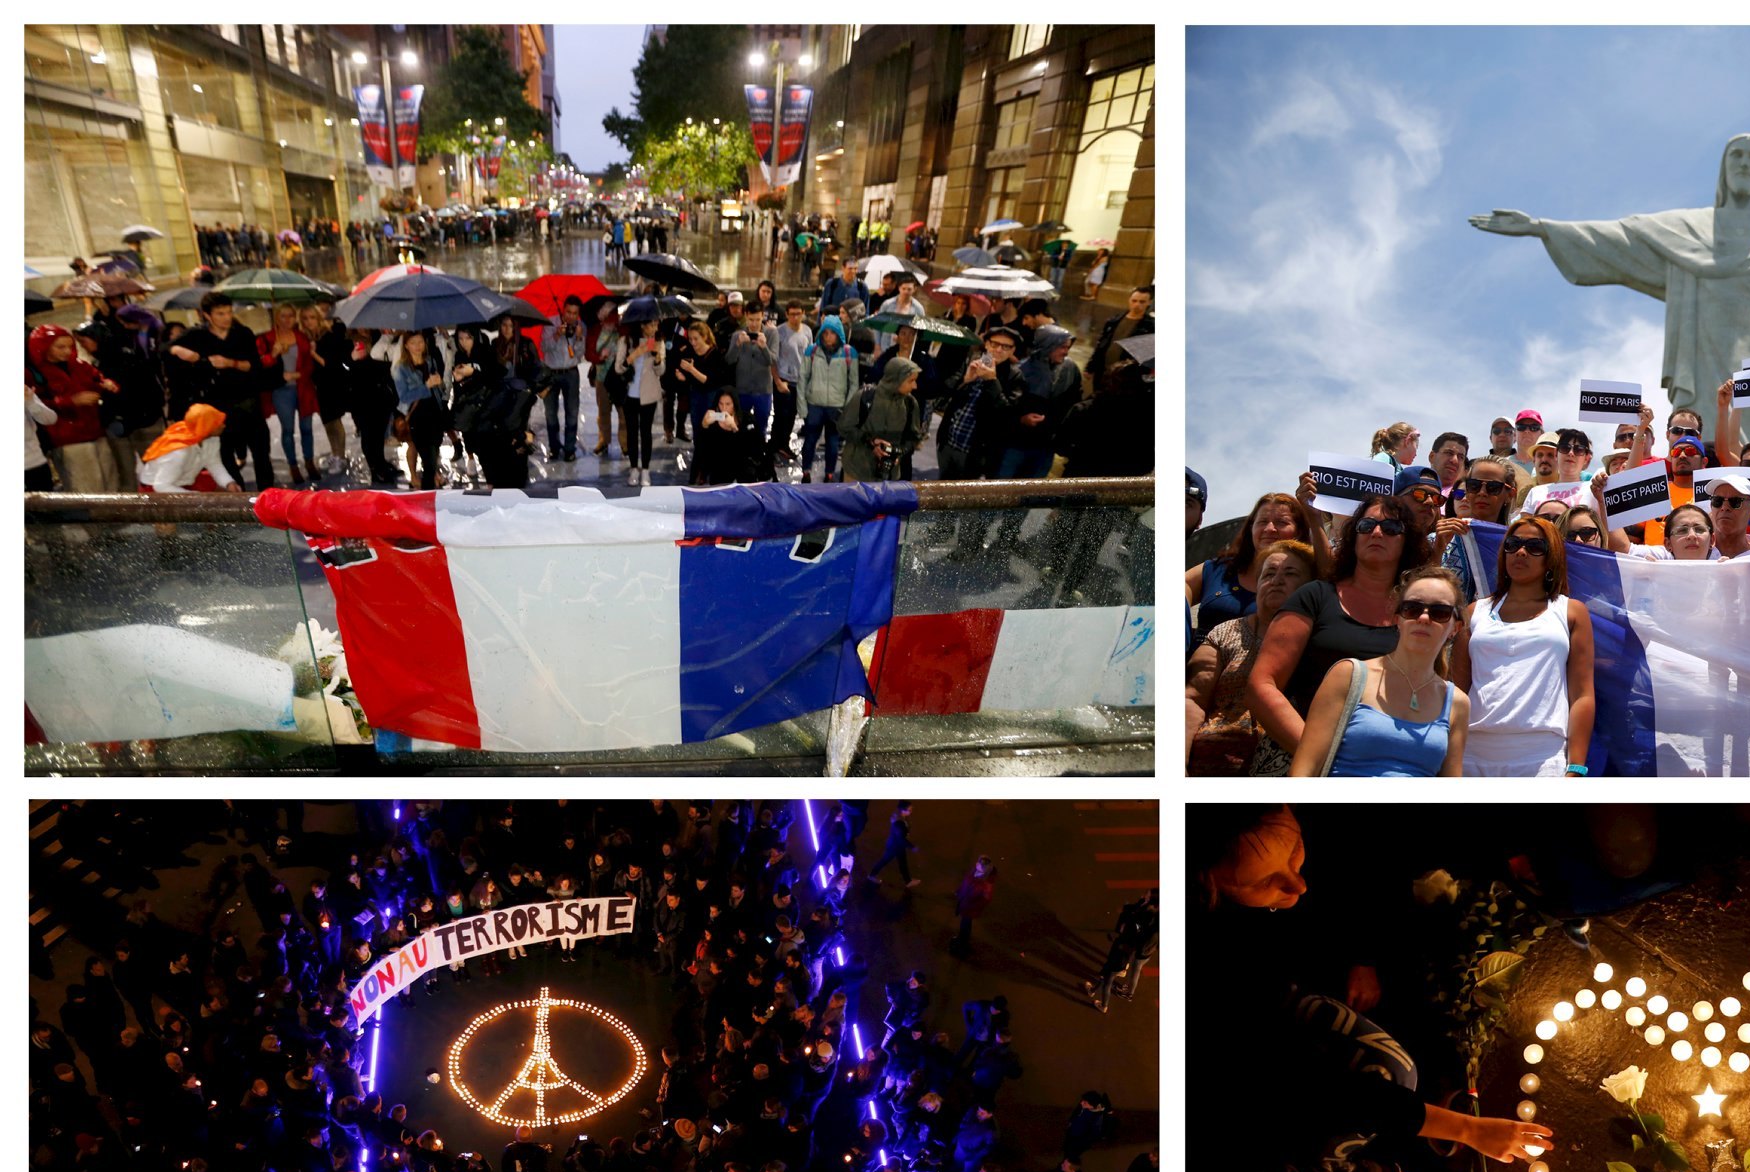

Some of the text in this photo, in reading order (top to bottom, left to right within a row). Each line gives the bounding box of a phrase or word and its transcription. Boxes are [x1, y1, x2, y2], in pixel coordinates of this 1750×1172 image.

[1733, 382, 1749, 391] RIO
[1581, 395, 1640, 407] RIO EST PARIS
[1311, 471, 1391, 496] RIO EST PARIS
[1605, 480, 1667, 507] RIO EST PARIS
[350, 898, 634, 1021] NON AU TERRORISME
